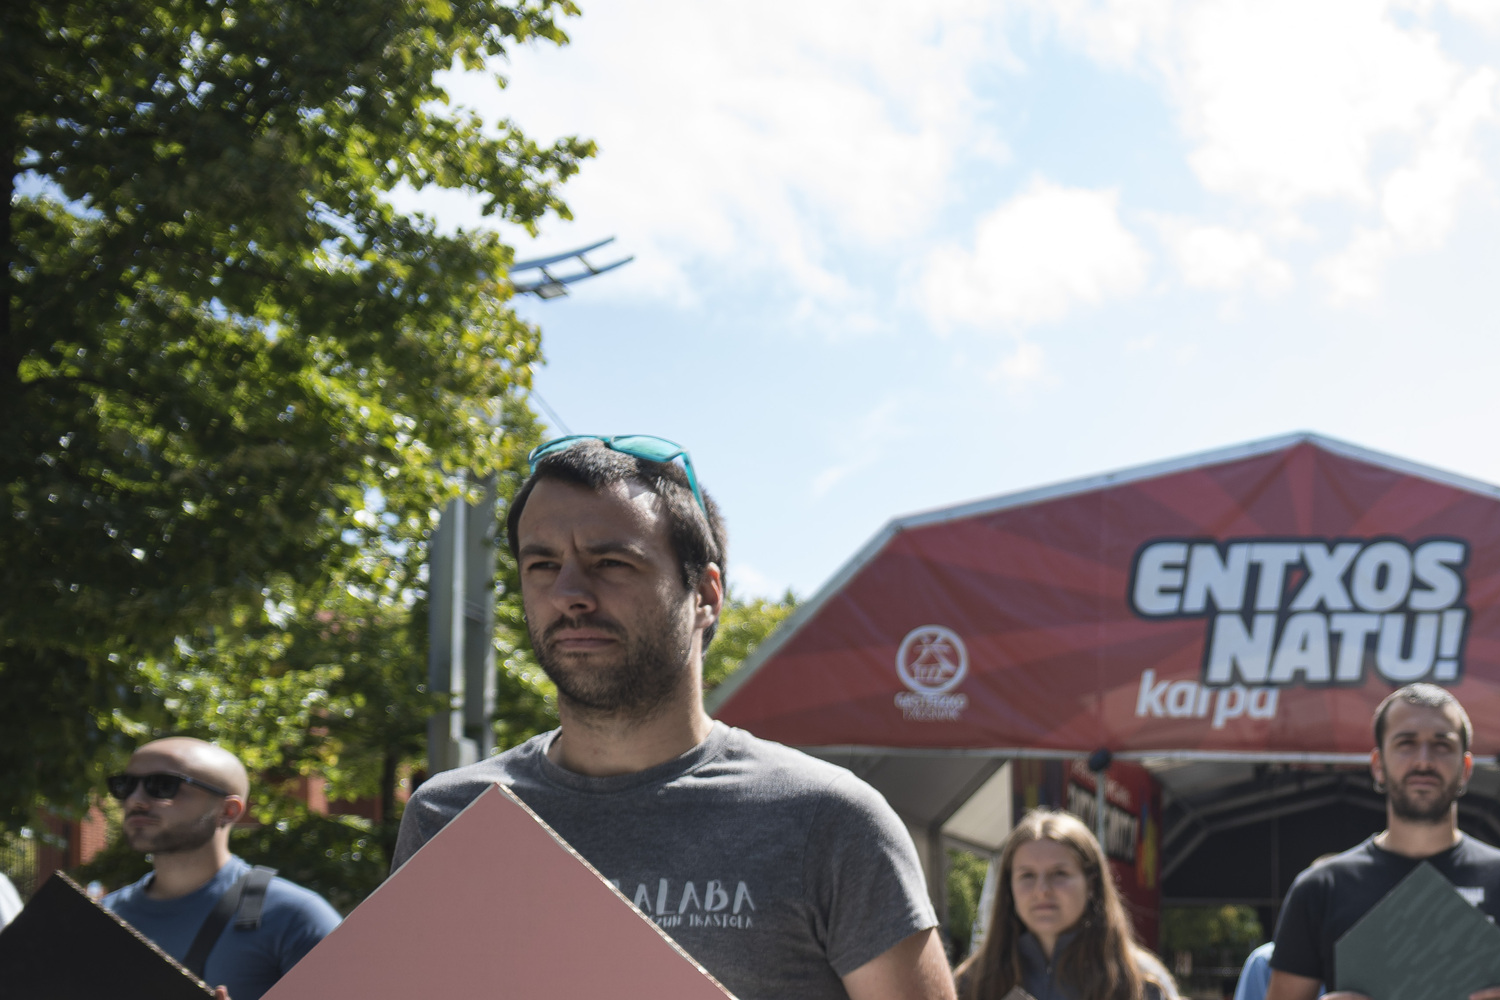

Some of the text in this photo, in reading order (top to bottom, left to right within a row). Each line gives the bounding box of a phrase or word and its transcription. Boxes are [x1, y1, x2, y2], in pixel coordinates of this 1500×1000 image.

[1133, 540, 1466, 615] ENTXOS
[1206, 608, 1467, 684] NATU!
[1135, 669, 1280, 729] karpa
[609, 877, 756, 916] ALABA
